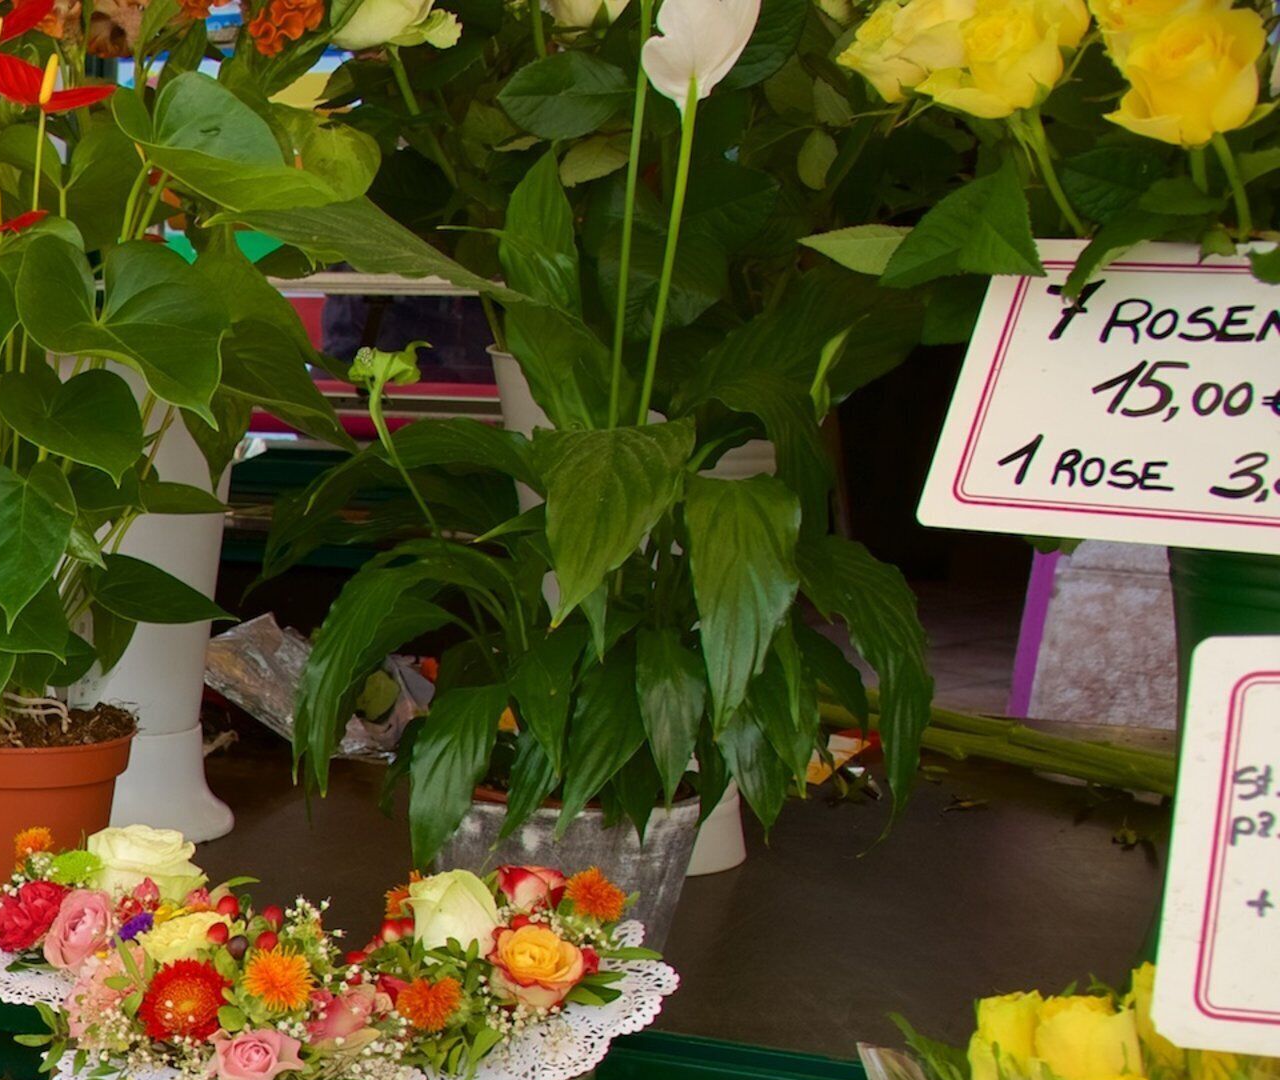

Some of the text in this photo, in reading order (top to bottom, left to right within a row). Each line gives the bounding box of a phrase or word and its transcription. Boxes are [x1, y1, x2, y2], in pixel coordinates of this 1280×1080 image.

[1046, 278, 1106, 340] 7
[997, 433, 1280, 503] 1 ROSE 3,
